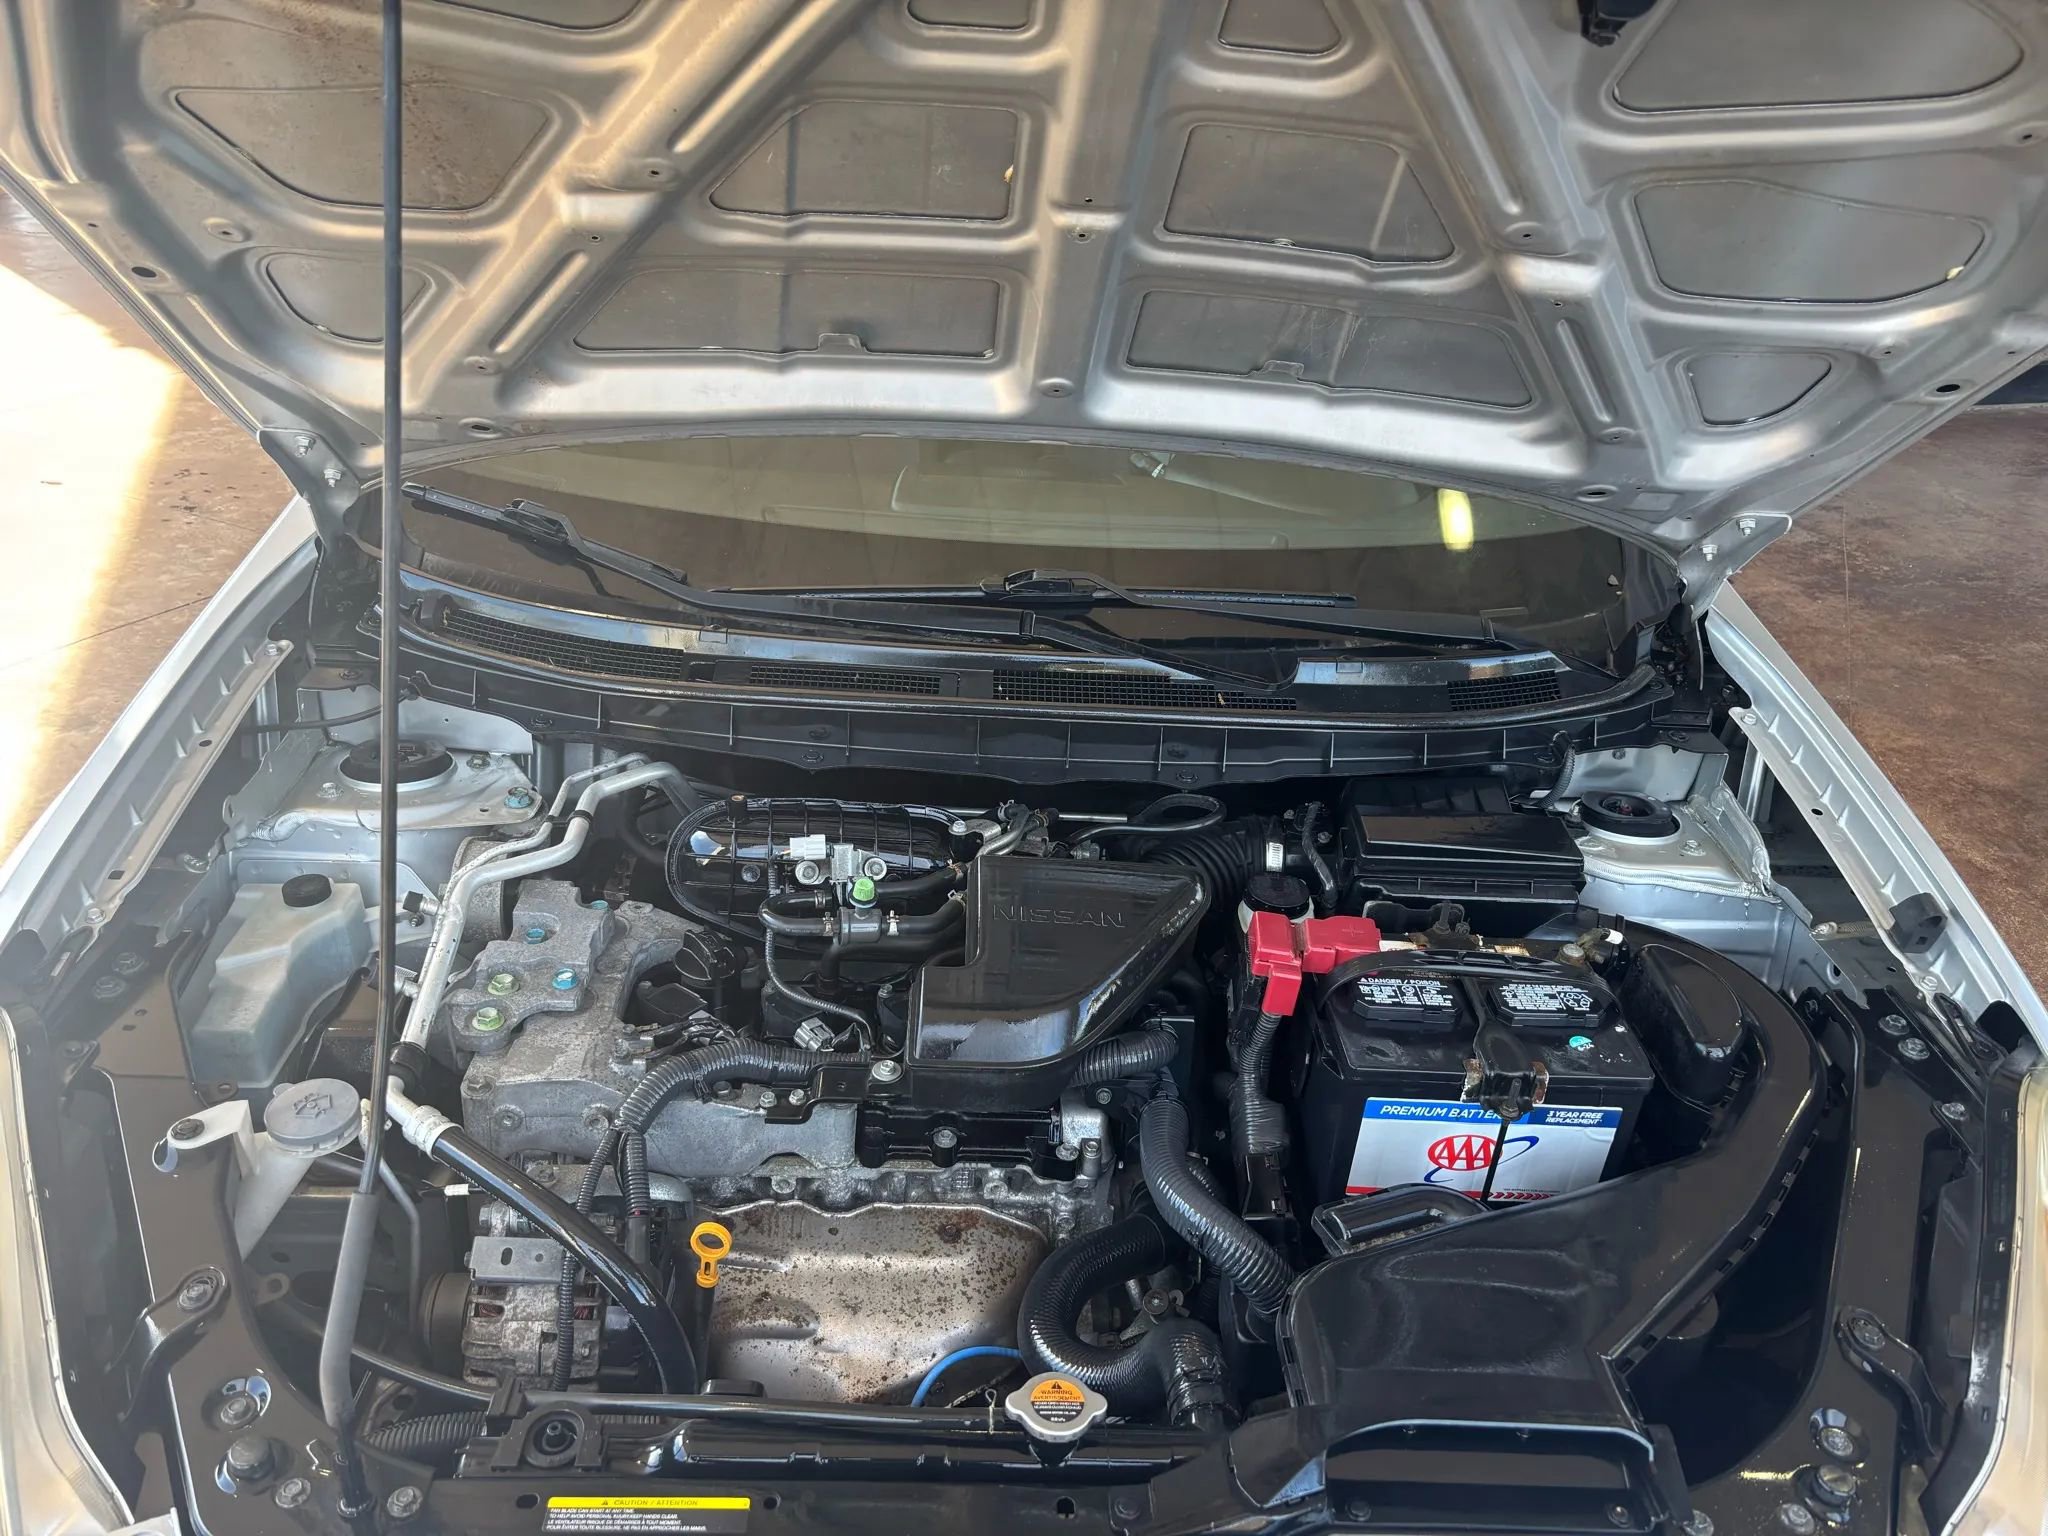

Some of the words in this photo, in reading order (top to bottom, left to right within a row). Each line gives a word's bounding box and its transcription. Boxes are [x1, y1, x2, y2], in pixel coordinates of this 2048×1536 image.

[993, 904, 1126, 928] NISSAN
[1367, 977, 1402, 985] DANGER
[1380, 1105, 1447, 1118] PREMIUM
[1555, 1110, 1579, 1118] YEAR
[1579, 1111, 1604, 1119] FREE
[1434, 1136, 1492, 1171] AAA
